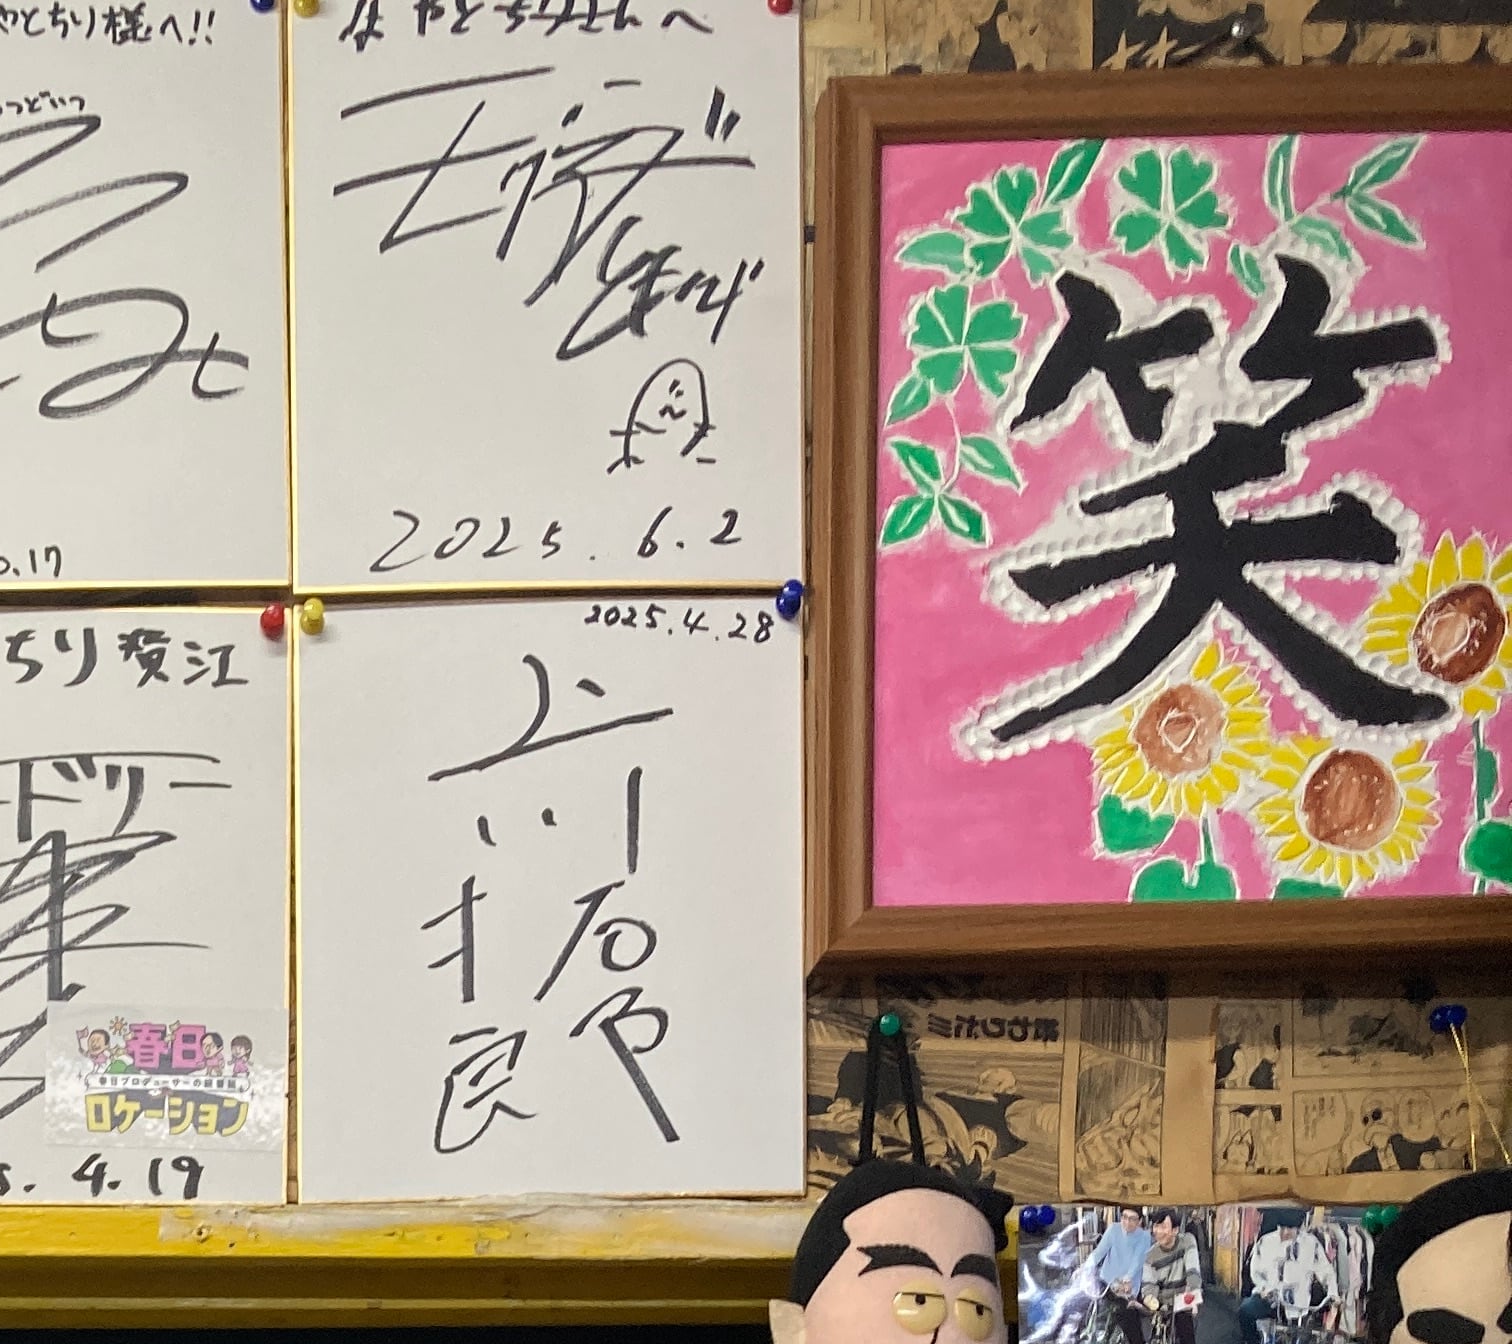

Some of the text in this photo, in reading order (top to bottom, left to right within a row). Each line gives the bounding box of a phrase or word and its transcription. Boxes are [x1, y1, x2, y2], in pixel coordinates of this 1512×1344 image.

[991, 254, 1452, 742] 笑
[369, 505, 742, 573] 2025.6.2
[584, 603, 775, 643] 2025.4.28
[125, 1022, 207, 1069] 春日
[84, 1093, 250, 1137] ロケーション
